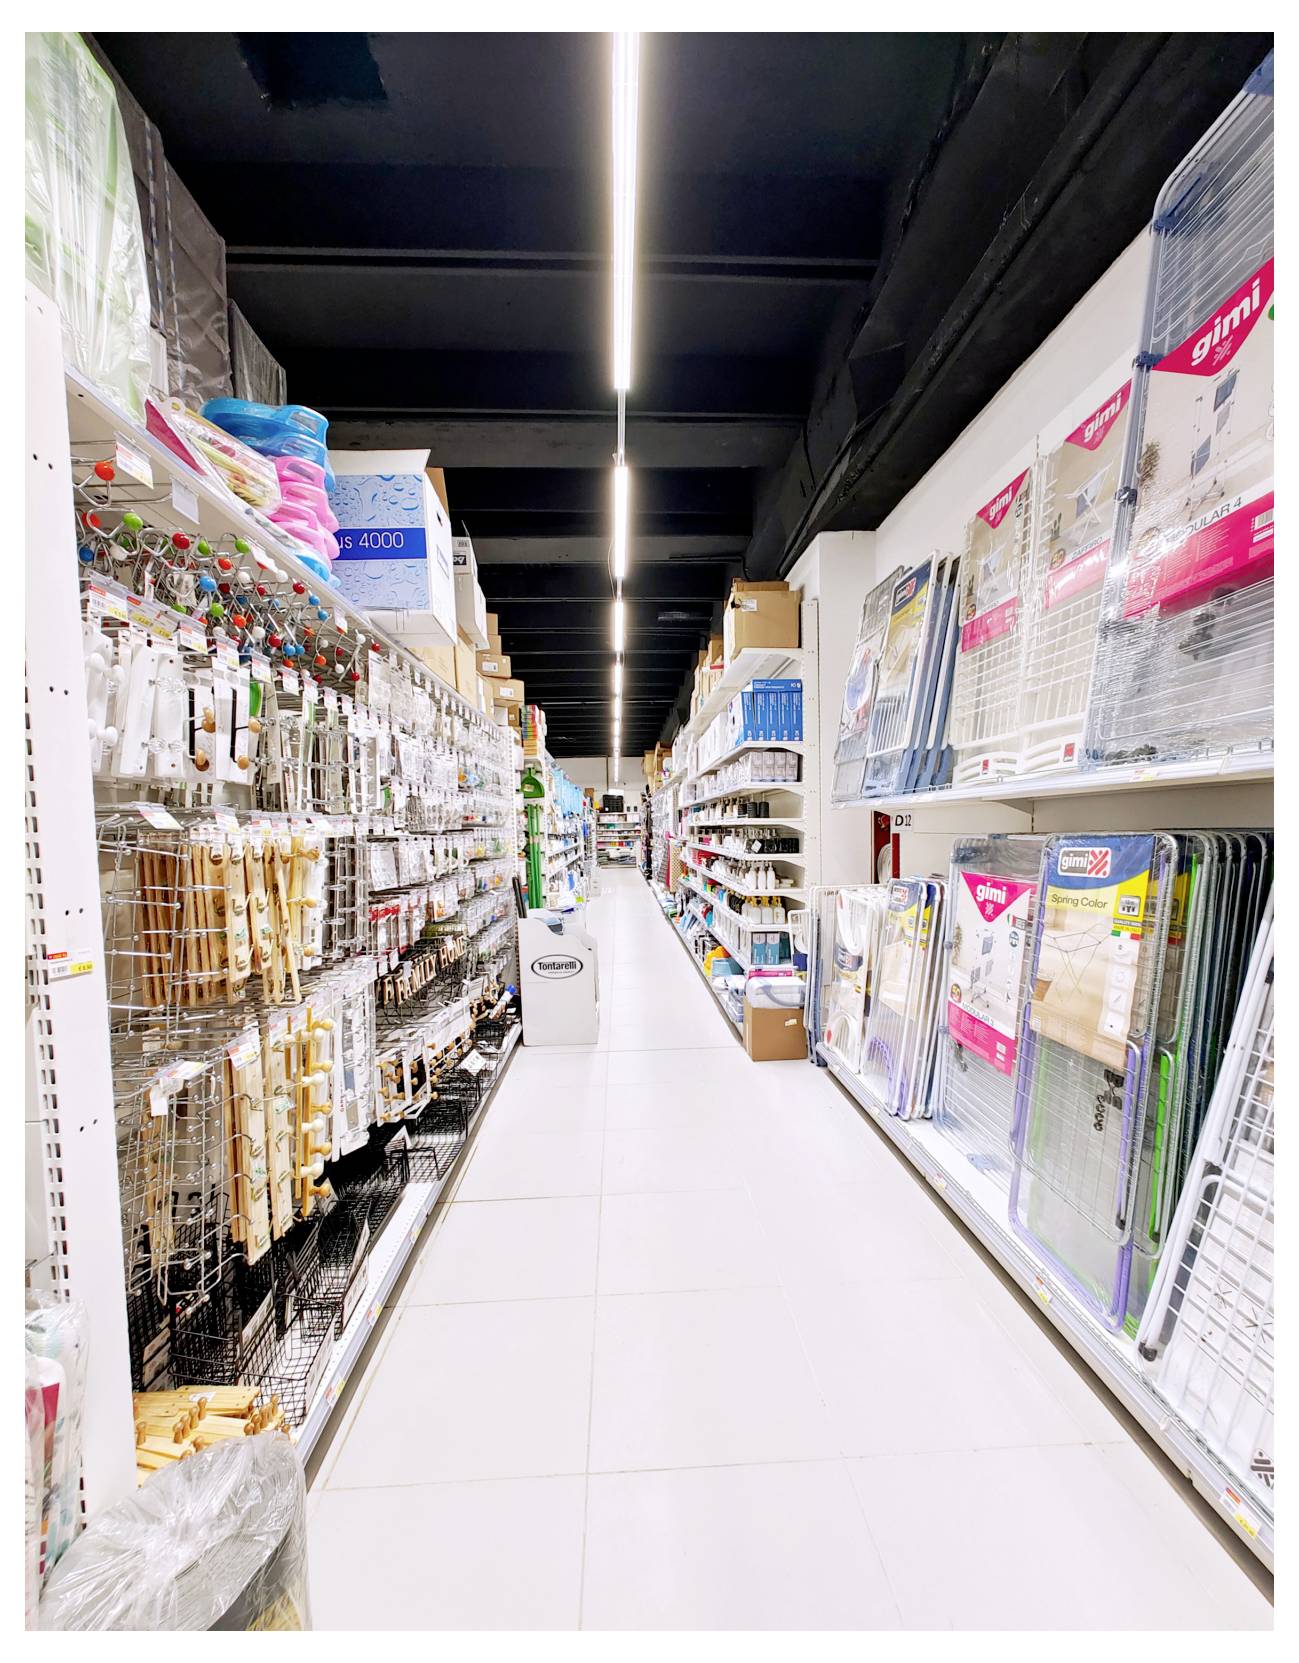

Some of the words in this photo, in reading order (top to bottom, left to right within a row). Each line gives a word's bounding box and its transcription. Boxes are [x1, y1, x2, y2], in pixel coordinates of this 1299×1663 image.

[1191, 277, 1260, 367] gimi
[1083, 392, 1122, 443] gimi
[988, 487, 1013, 520] gimi
[1234, 497, 1242, 508] 4
[359, 532, 404, 549] 4000
[1061, 852, 1089, 870] gimi
[976, 882, 1007, 905] gimi
[1051, 893, 1079, 908] Spring
[1080, 896, 1108, 909] Color
[537, 961, 577, 971] Tontarelli
